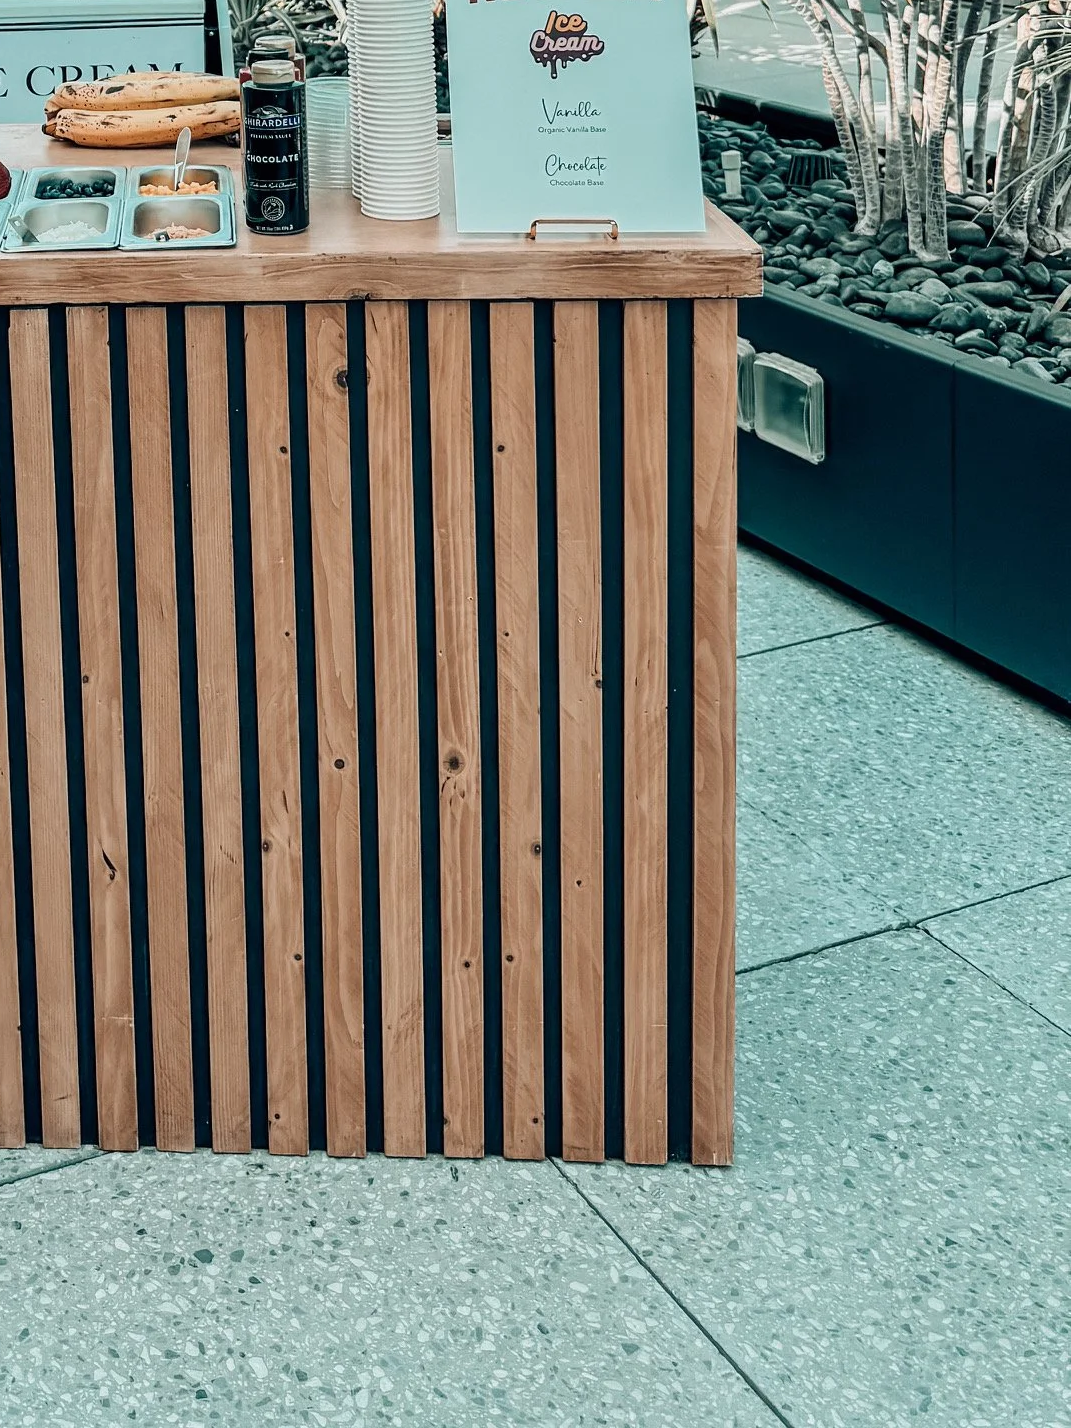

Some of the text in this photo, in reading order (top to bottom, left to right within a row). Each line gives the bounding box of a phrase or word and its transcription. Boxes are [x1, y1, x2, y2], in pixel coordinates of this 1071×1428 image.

[544, 10, 588, 34] Ice
[530, 29, 605, 54] Cream
[541, 98, 602, 125] Vanilla
[537, 126, 565, 134] Organic
[246, 154, 300, 164] CHOCOLATE
[545, 154, 608, 176] Chocolate
[549, 179, 586, 187] Chocolate
